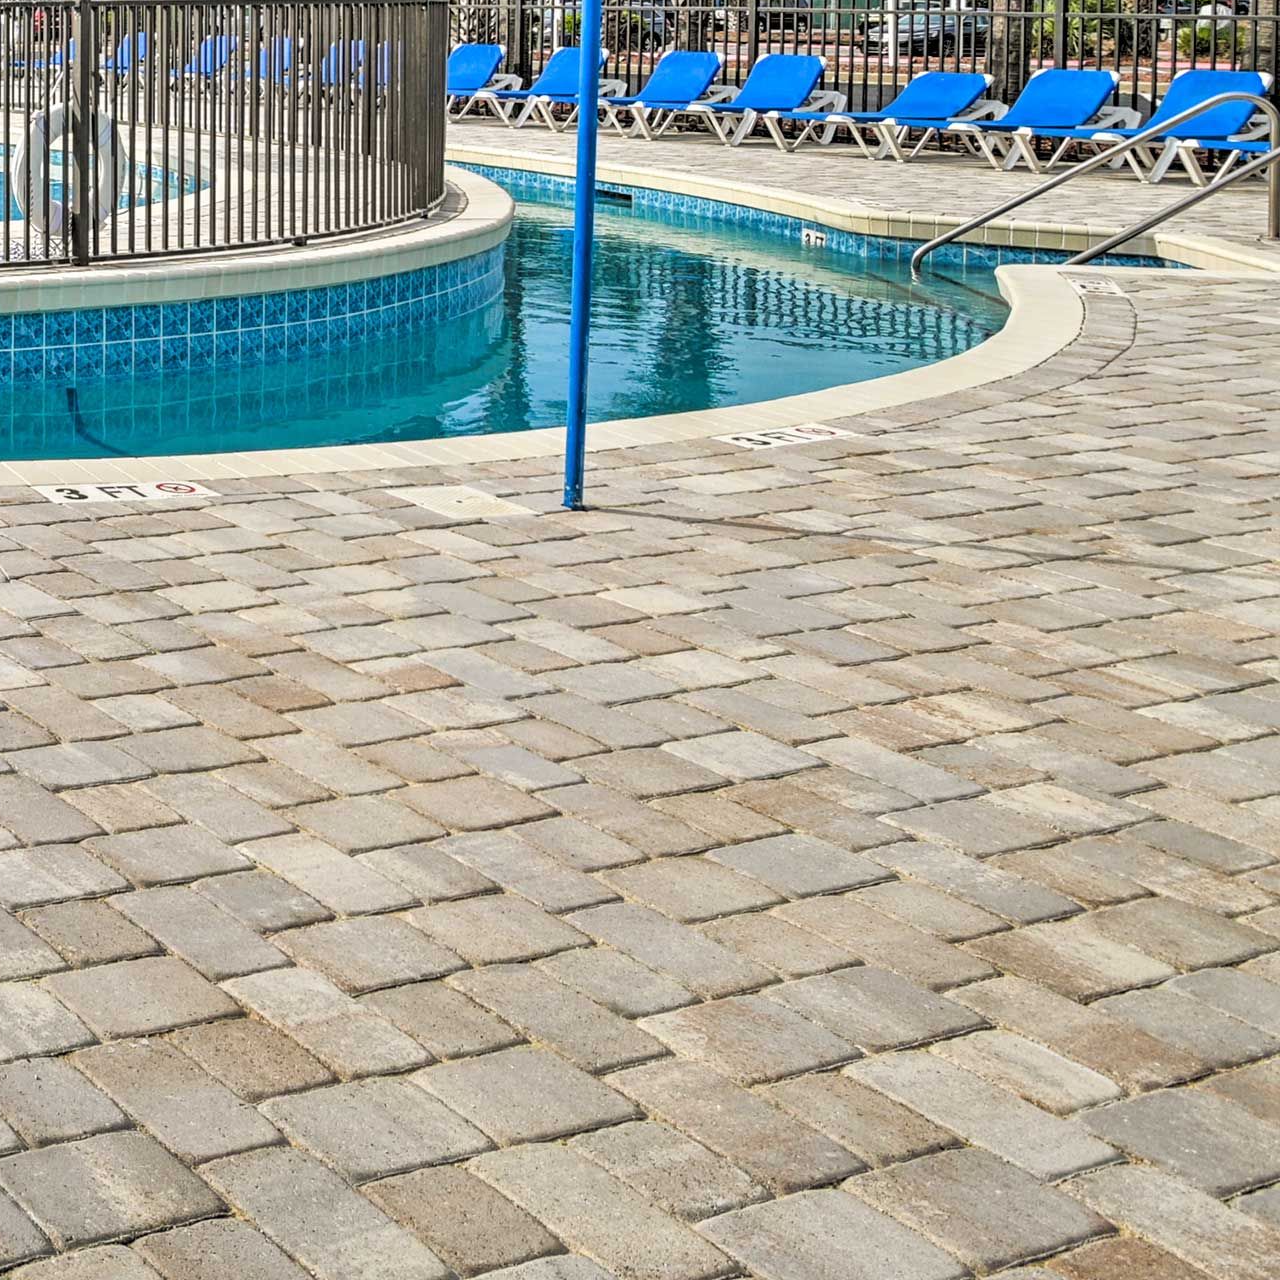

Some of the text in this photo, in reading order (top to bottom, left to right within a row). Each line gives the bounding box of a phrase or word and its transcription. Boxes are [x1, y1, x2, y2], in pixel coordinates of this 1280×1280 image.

[731, 431, 812, 445] 3 FT
[55, 485, 148, 500] 3 FT
